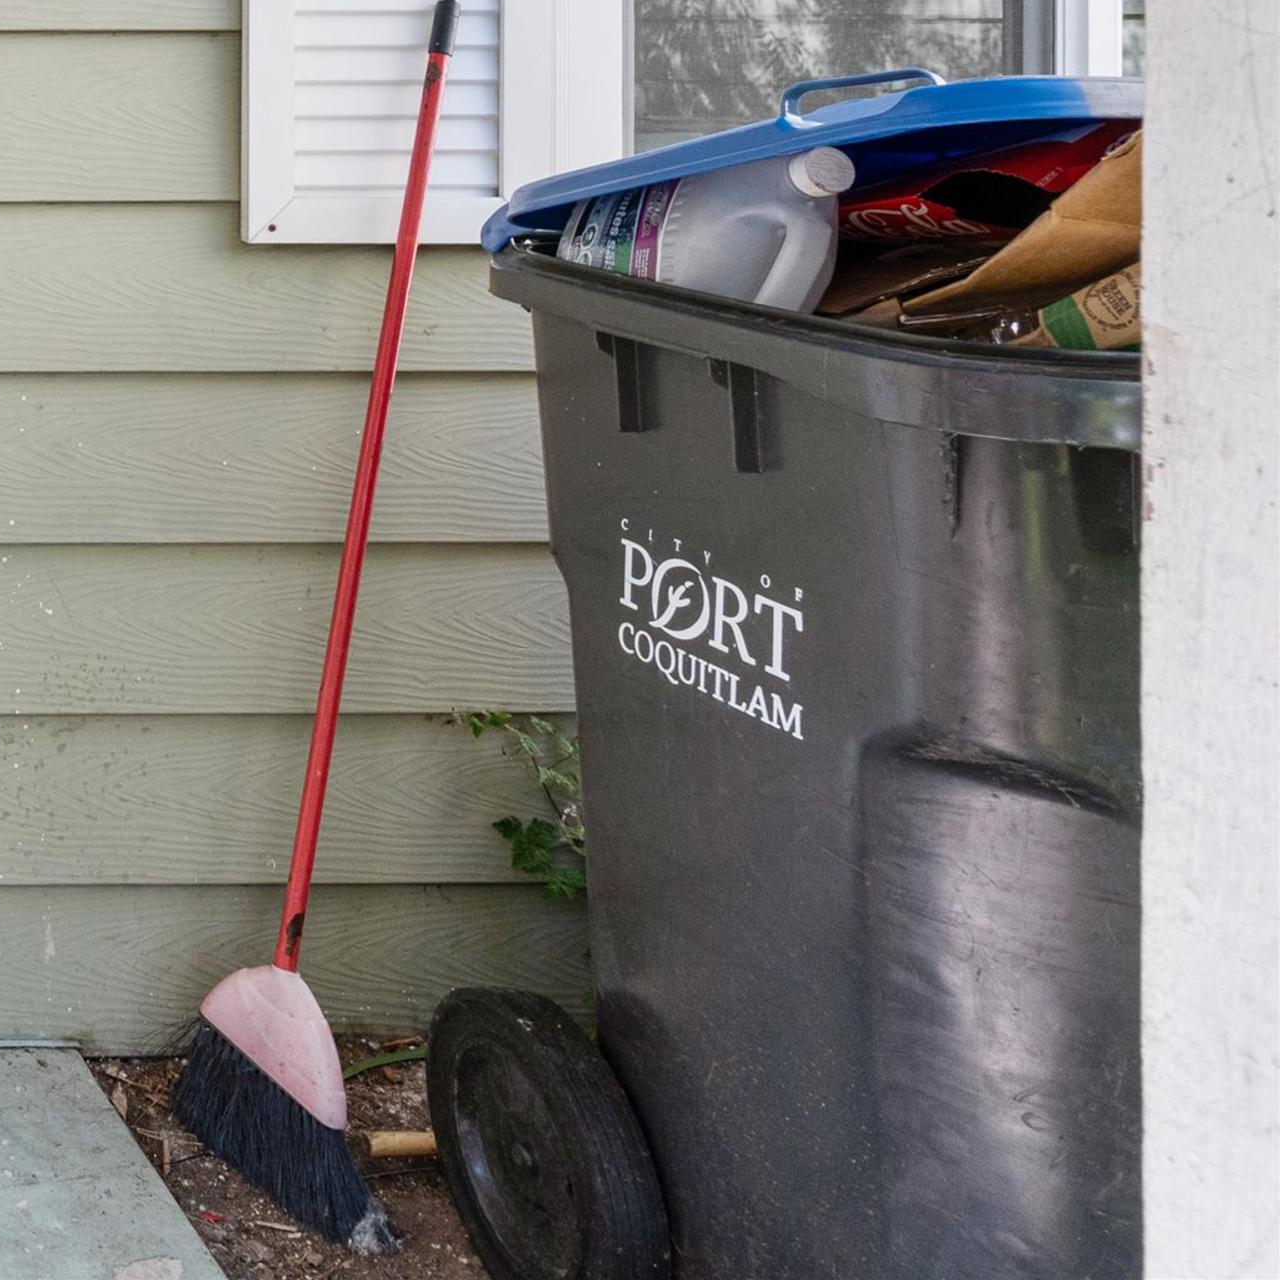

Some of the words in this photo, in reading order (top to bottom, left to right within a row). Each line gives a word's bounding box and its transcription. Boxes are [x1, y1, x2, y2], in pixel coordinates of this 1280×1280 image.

[619, 538, 803, 681] PORT
[620, 518, 712, 564] CITY
[760, 574, 803, 602] OF
[619, 622, 804, 740] COQUITLAM
